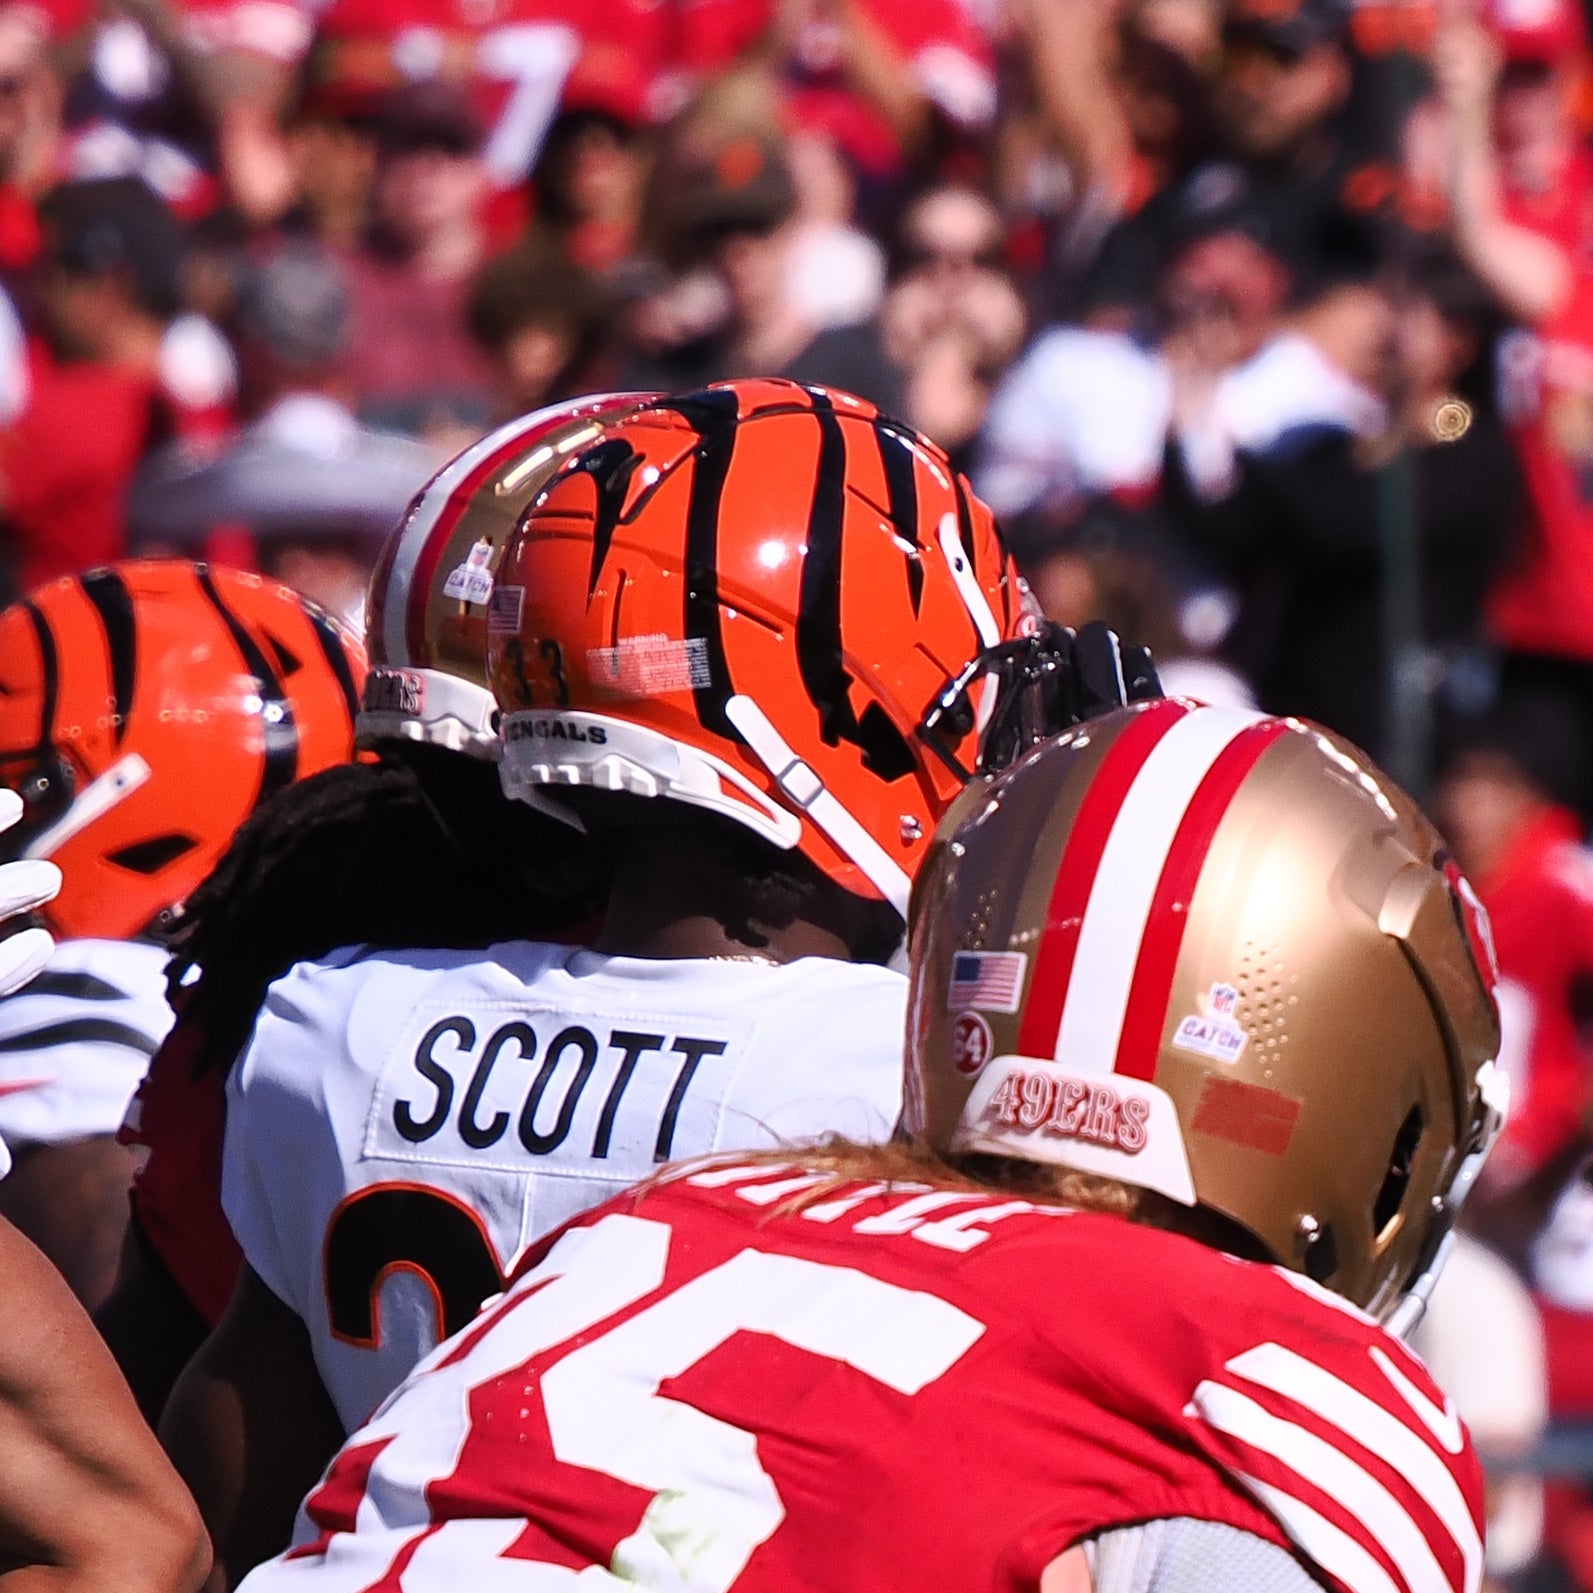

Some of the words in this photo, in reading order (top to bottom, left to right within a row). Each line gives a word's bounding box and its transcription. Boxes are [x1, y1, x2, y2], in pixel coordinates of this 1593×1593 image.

[503, 717, 608, 745] ENGALS
[393, 1016, 729, 1163] SCOTT
[990, 1069, 1151, 1156] 49ERS
